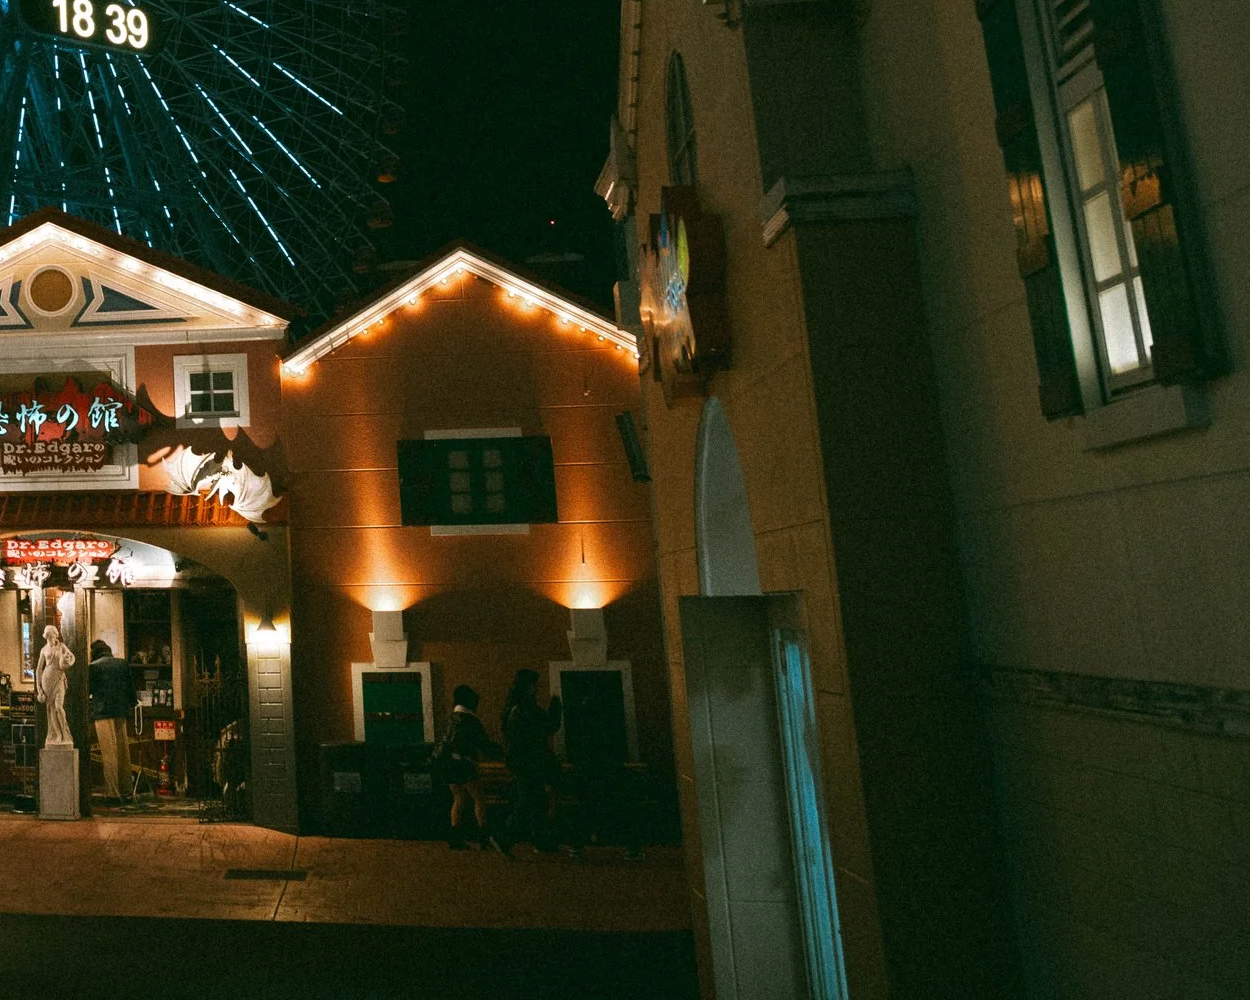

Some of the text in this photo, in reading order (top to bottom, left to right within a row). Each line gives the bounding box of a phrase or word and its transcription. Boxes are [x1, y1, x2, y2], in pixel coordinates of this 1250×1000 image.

[3, 454, 104, 465] 呪いのコレクション
